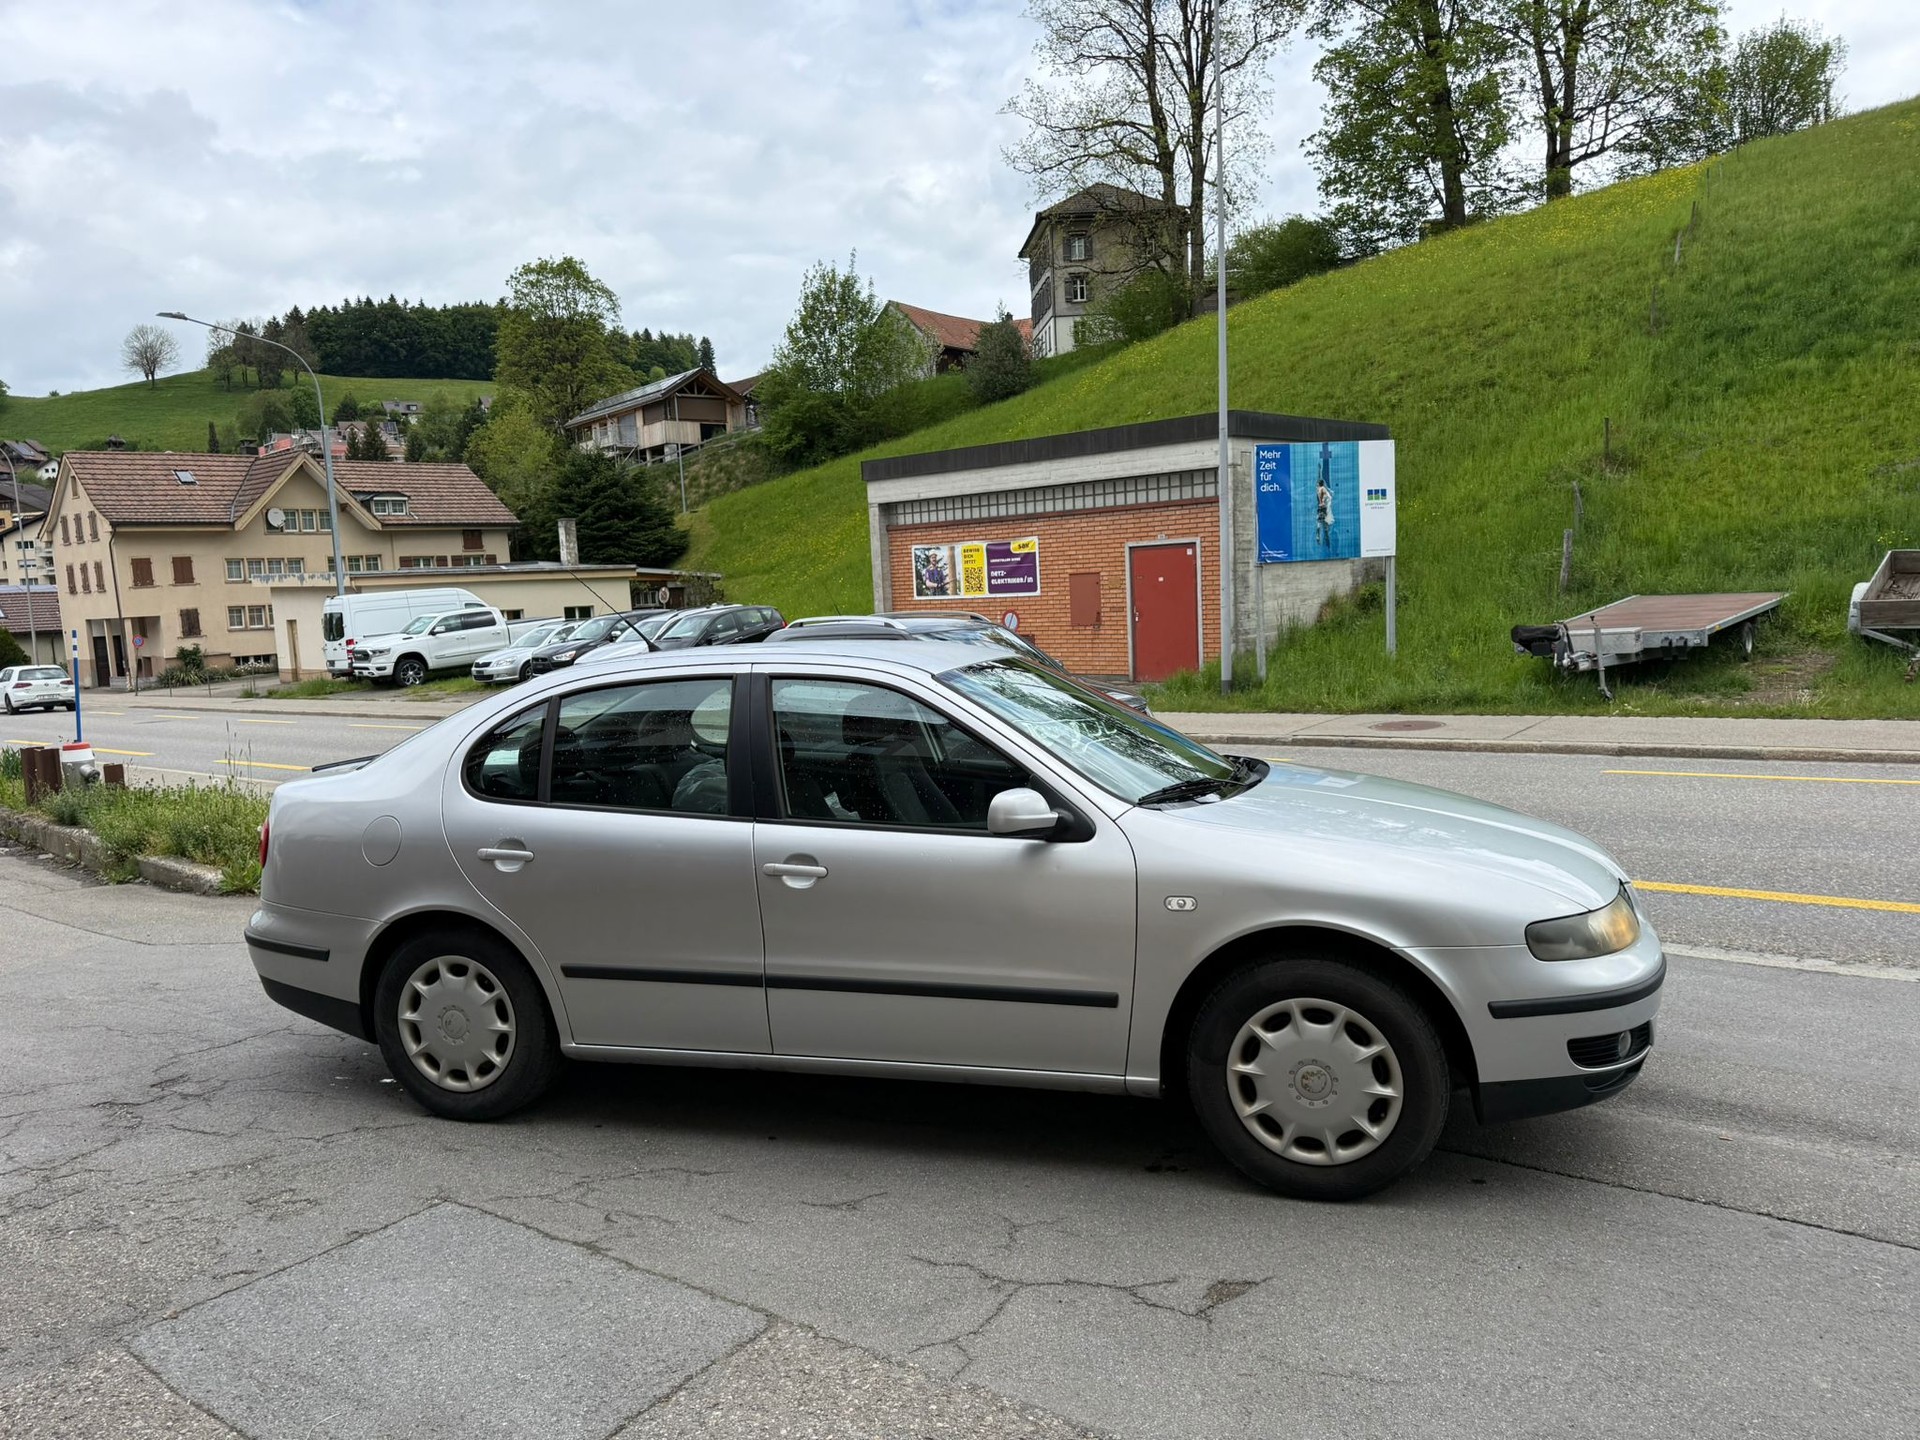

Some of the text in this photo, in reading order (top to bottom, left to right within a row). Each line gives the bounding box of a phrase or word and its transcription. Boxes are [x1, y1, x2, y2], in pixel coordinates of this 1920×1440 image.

[1259, 450, 1281, 459] Mehr
[1260, 461, 1277, 470] Zeit
[1260, 472, 1272, 481] für
[1260, 483, 1282, 492] dich.
